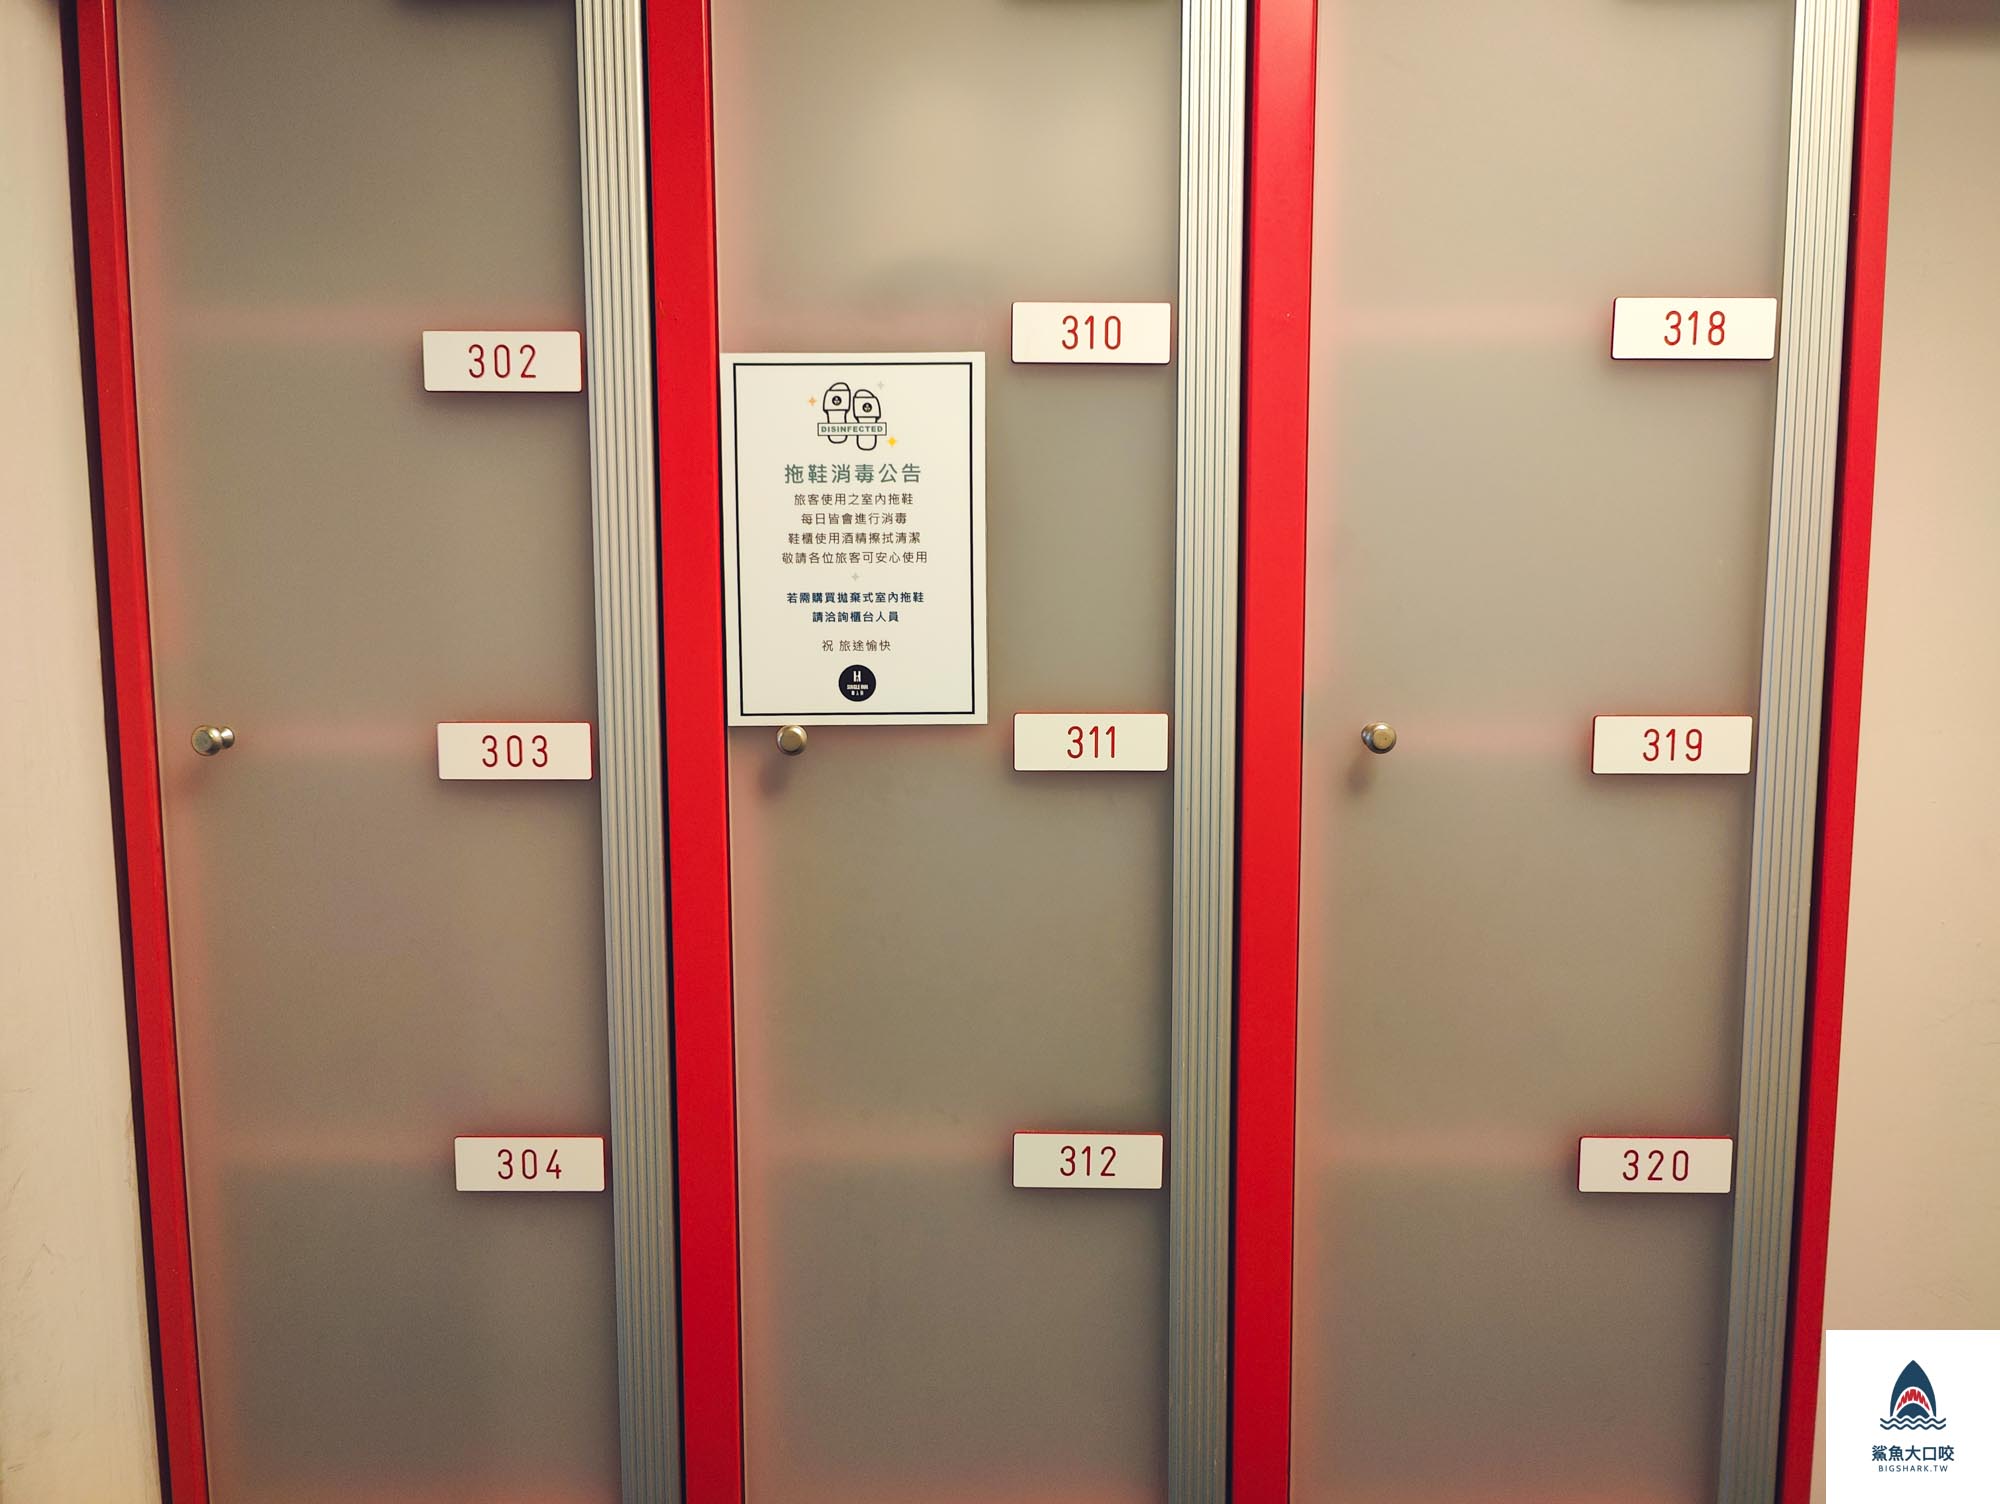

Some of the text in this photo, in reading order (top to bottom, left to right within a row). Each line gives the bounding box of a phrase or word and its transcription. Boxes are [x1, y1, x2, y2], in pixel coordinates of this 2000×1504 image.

[1062, 315, 1122, 351] 310
[1663, 310, 1726, 347] 318
[469, 344, 537, 379] 302
[820, 425, 884, 434] DISINFECTED
[784, 463, 921, 484] 拖鞋消毒公告
[793, 493, 914, 506] 旅客使用之室內拖鞋
[800, 512, 907, 525] 每日皆會進行消毒
[788, 532, 921, 545] 鞋櫃使用酒精擦拭清潔
[781, 551, 928, 564] 敬請各位旅客可安心使用
[812, 611, 900, 623] 請洽詢櫃台人員
[822, 639, 891, 652] 祝 旅途愉快
[483, 735, 549, 769] 303
[1067, 725, 1117, 760] 311
[1643, 728, 1703, 763] 319
[497, 1150, 562, 1180] 304
[1060, 1146, 1117, 1177] 312
[1622, 1150, 1690, 1182] 320
